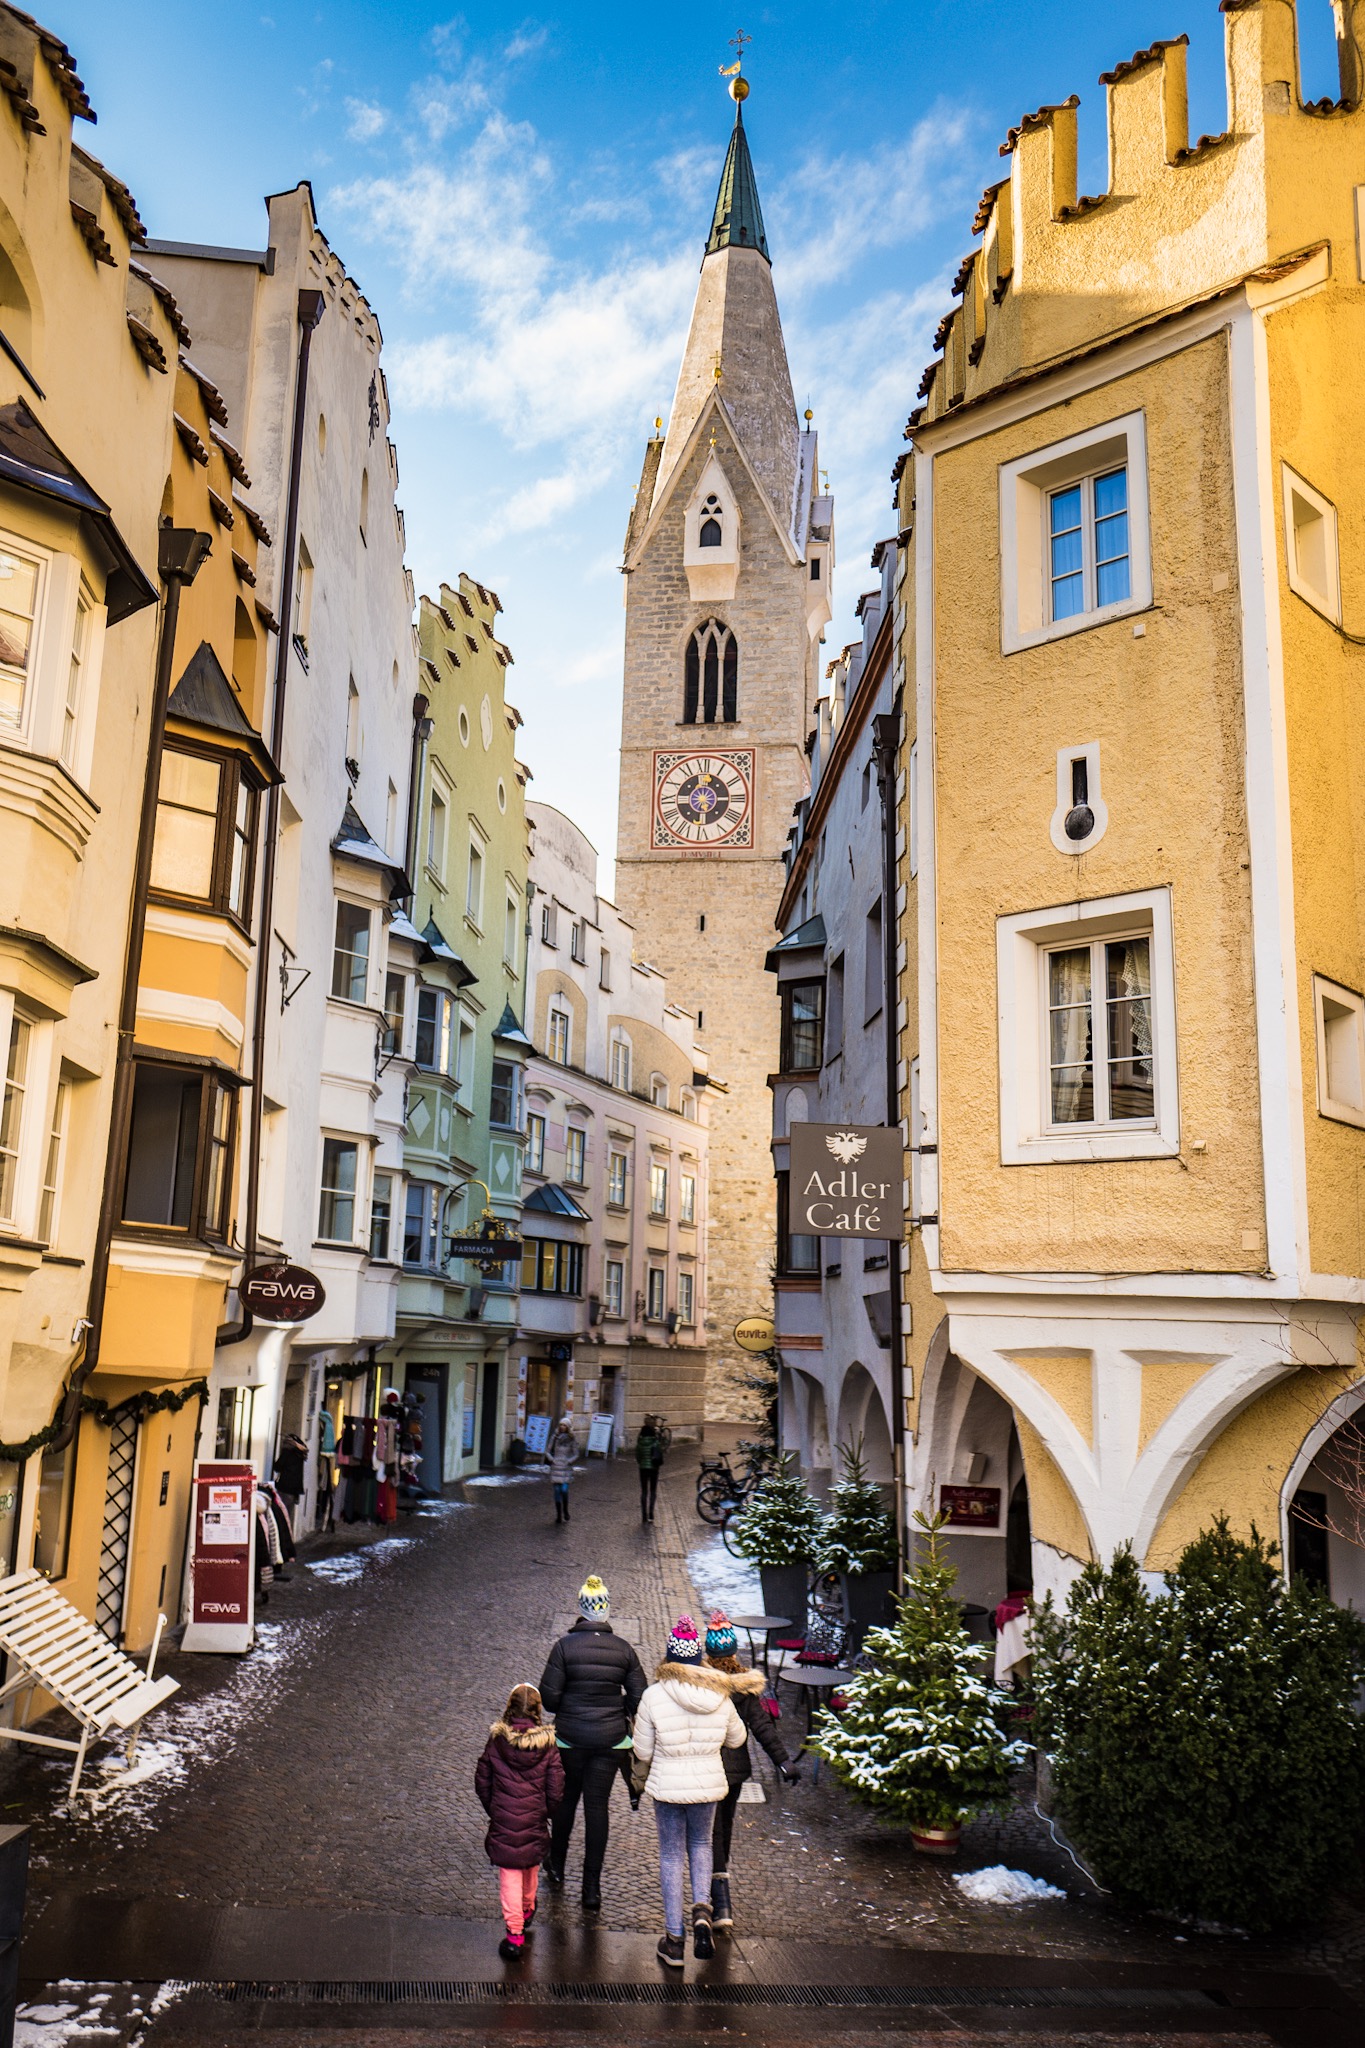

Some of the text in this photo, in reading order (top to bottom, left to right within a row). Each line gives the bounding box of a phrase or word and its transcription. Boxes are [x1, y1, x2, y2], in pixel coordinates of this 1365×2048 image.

[803, 1170, 891, 1199] Adler
[806, 1202, 881, 1232] Café
[454, 1245, 495, 1255] FARMACIA
[737, 1329, 767, 1339] euvita
